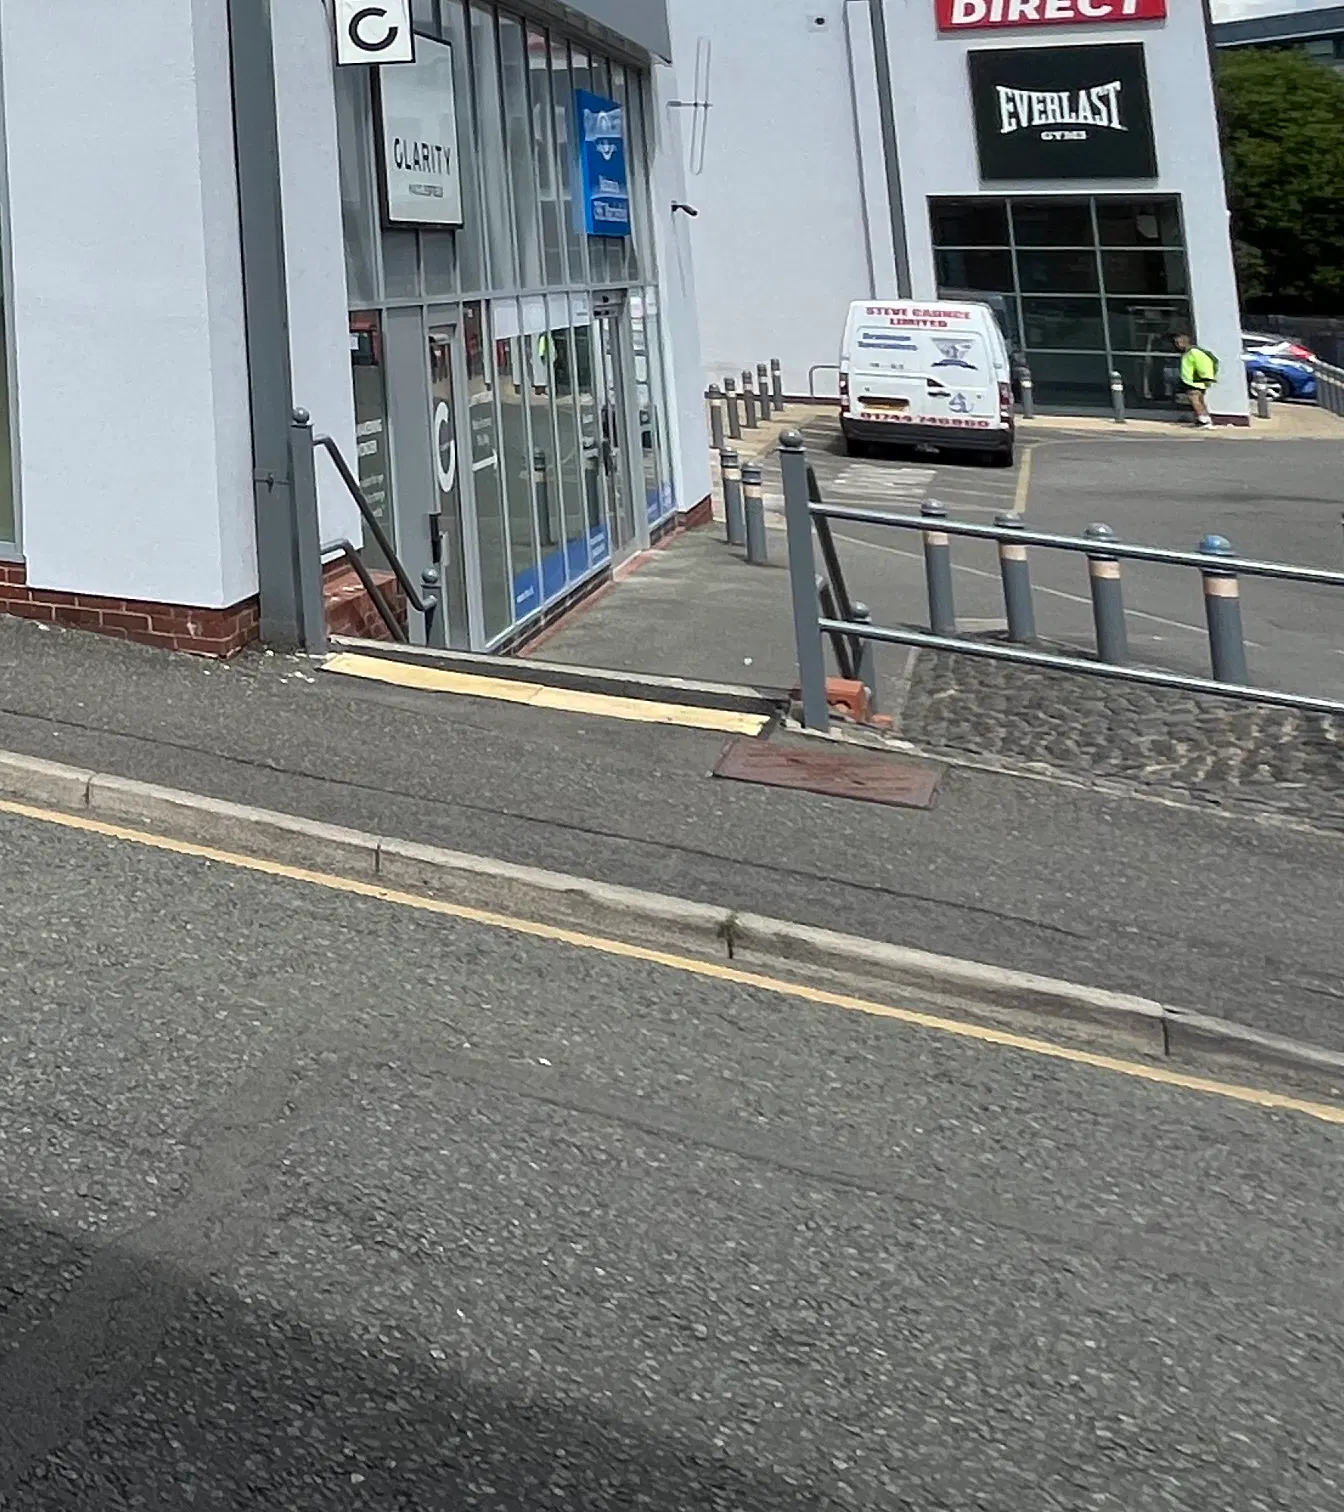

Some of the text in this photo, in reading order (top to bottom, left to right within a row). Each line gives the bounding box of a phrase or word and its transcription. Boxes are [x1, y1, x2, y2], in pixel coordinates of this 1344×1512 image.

[348, 7, 399, 52] C
[995, 80, 1129, 134] EVERLAST
[393, 138, 451, 176] CLARITY
[889, 318, 948, 327] LIMITED
